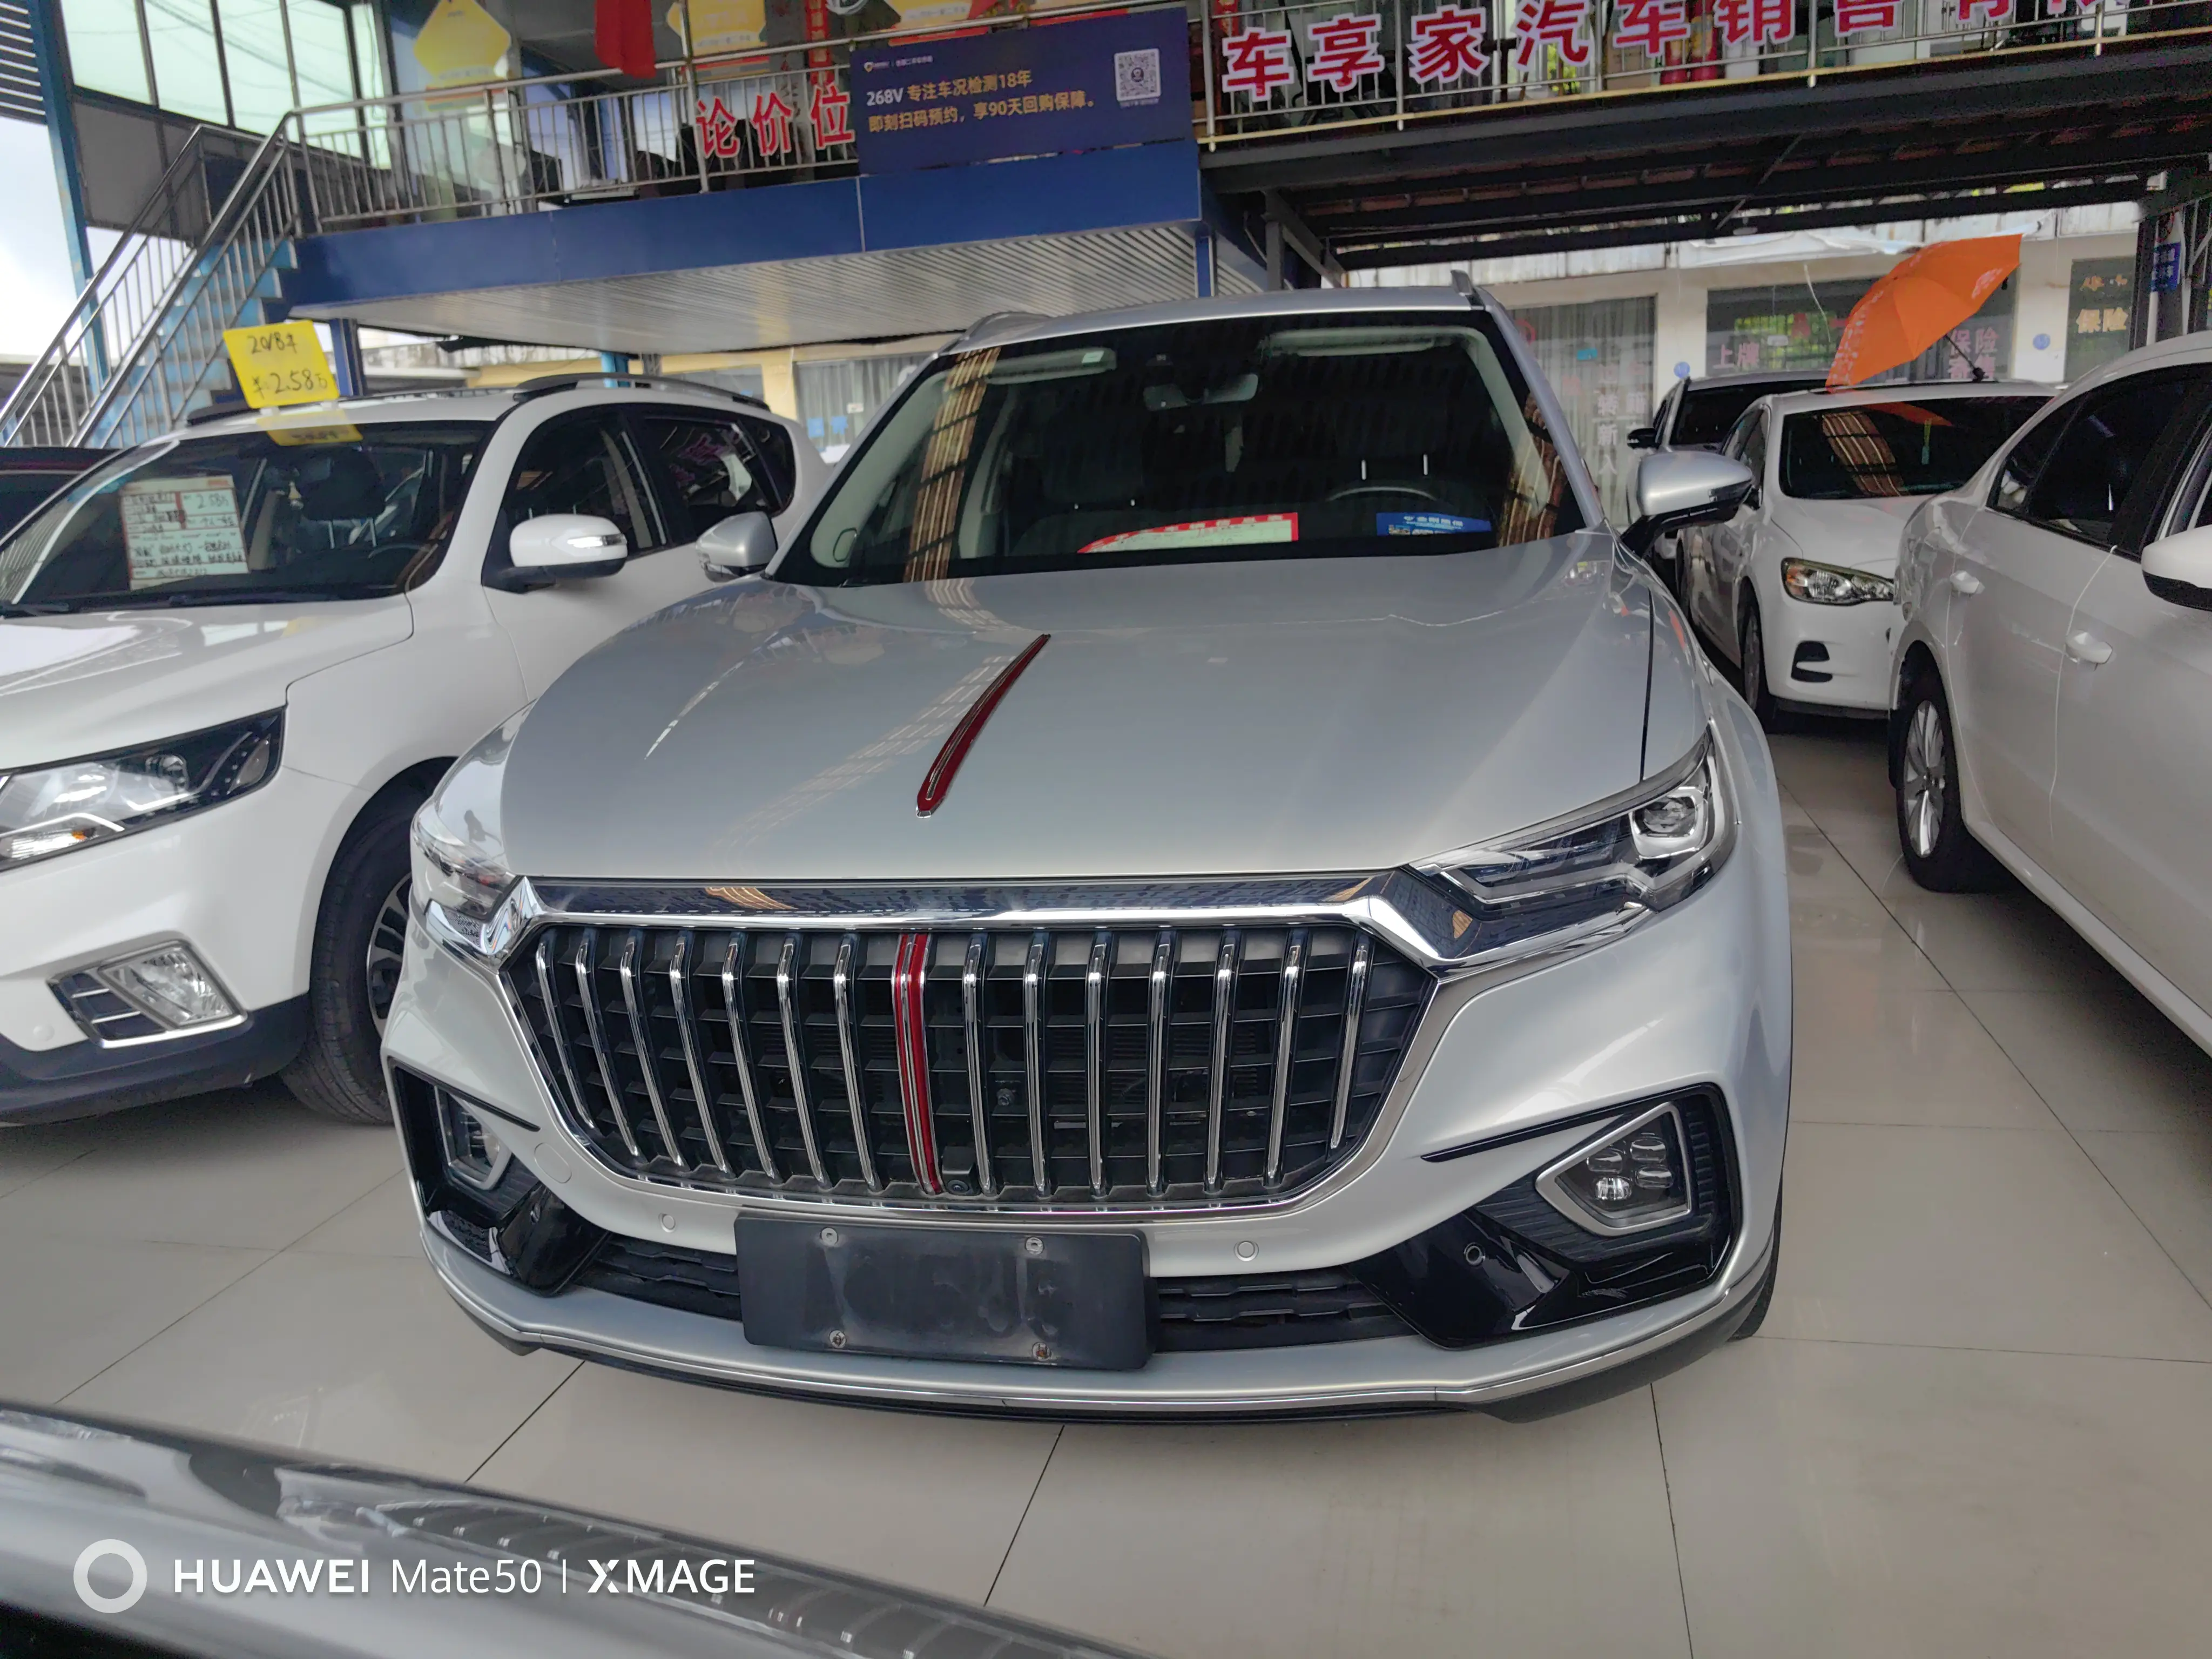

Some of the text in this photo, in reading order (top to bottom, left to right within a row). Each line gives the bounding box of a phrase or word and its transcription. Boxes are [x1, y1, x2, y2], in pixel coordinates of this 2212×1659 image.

[866, 69, 1033, 106] 268V 专注车况检测18年
[696, 82, 855, 158] 论价位
[2076, 307, 2128, 333] 保险
[1950, 326, 2000, 354] 保险
